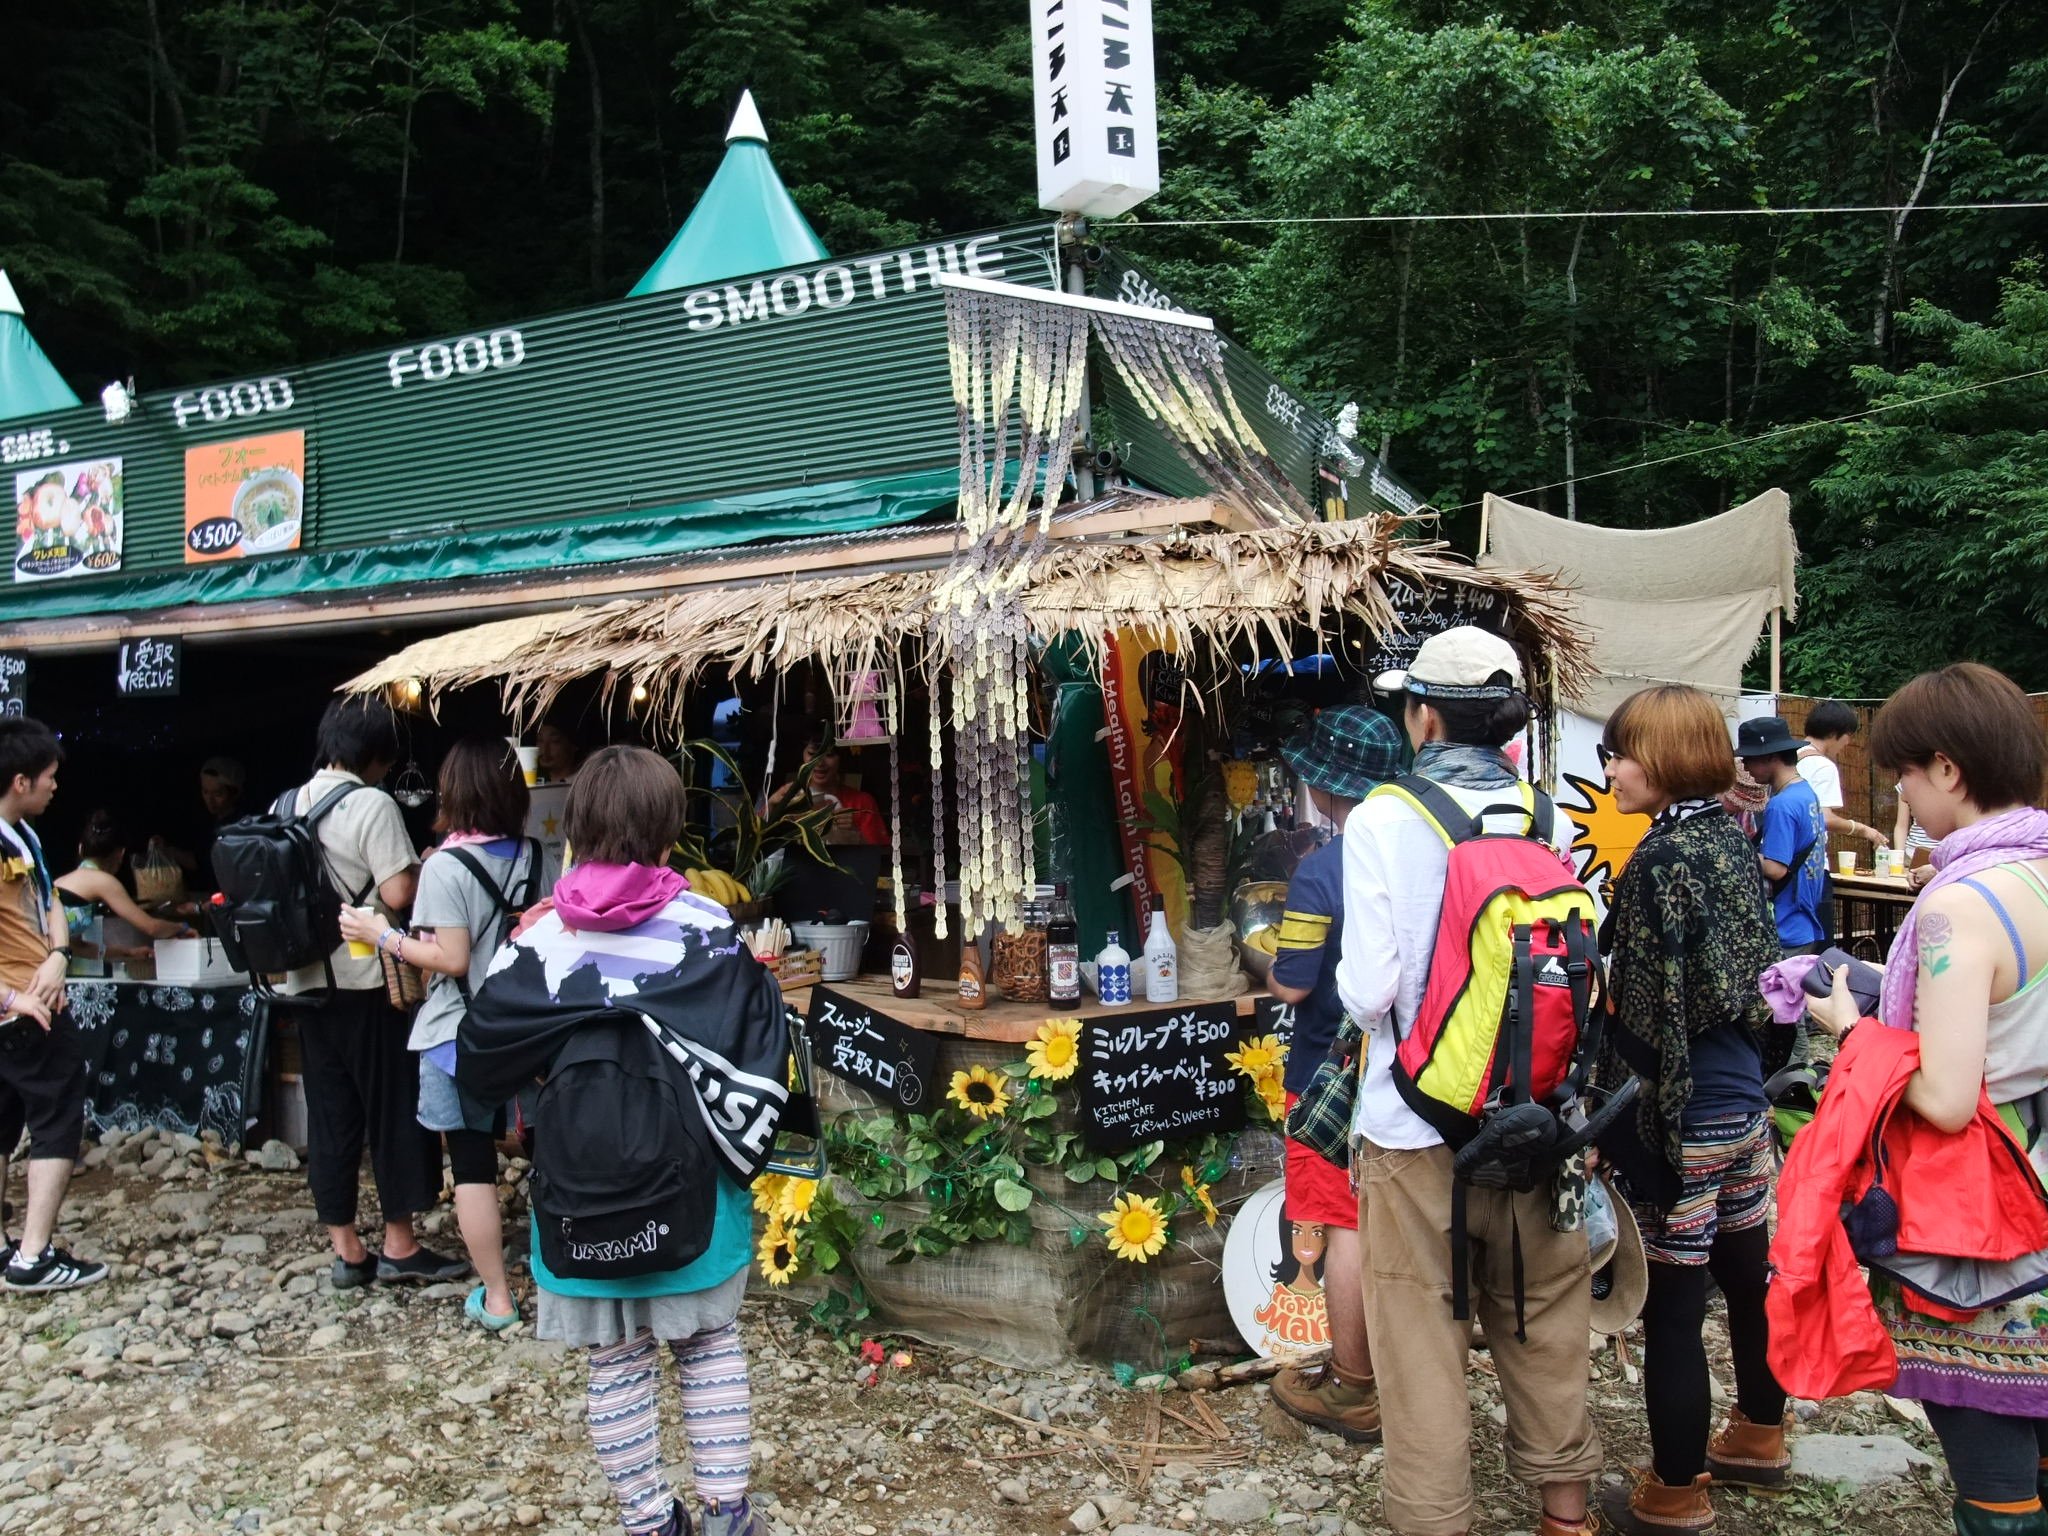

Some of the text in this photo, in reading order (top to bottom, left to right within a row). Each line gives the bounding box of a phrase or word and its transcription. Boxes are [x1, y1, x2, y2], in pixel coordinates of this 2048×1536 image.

[683, 235, 1006, 331] SMOOTHIE
[388, 329, 525, 389] FOOD
[173, 377, 294, 428] FOOD
[1454, 582, 1494, 609] ¥400
[135, 638, 175, 671] 受取
[129, 669, 174, 693] RECIVE
[1103, 680, 1127, 772] Healthy
[1117, 778, 1137, 837] Latin
[819, 1001, 885, 1042] スムージー
[1092, 1011, 1230, 1060] ミルクレープ ¥500
[832, 1035, 895, 1089] 受取口
[1194, 1076, 1236, 1101] ¥300
[1093, 1096, 1141, 1123] KITCHEN
[1133, 1103, 1156, 1119] CAFE
[1271, 1282, 1330, 1317] TROPIC
